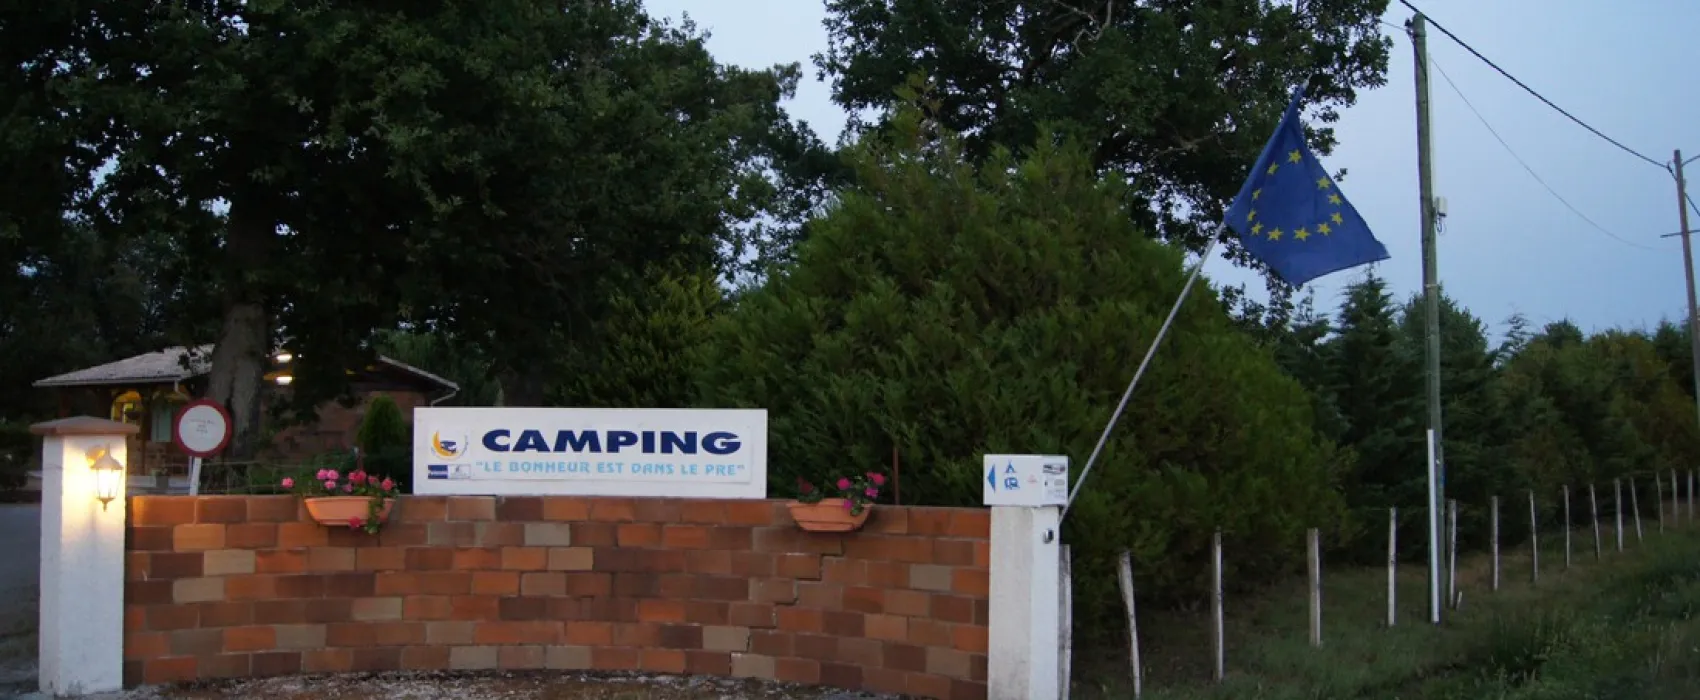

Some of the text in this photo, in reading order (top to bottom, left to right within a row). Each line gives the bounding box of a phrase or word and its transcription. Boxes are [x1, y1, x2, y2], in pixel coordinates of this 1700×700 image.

[481, 428, 743, 455] CAMPING
[509, 461, 590, 473] BONHEUR
[596, 462, 624, 474] EST
[631, 463, 674, 475] DANS
[680, 464, 698, 475] LE
